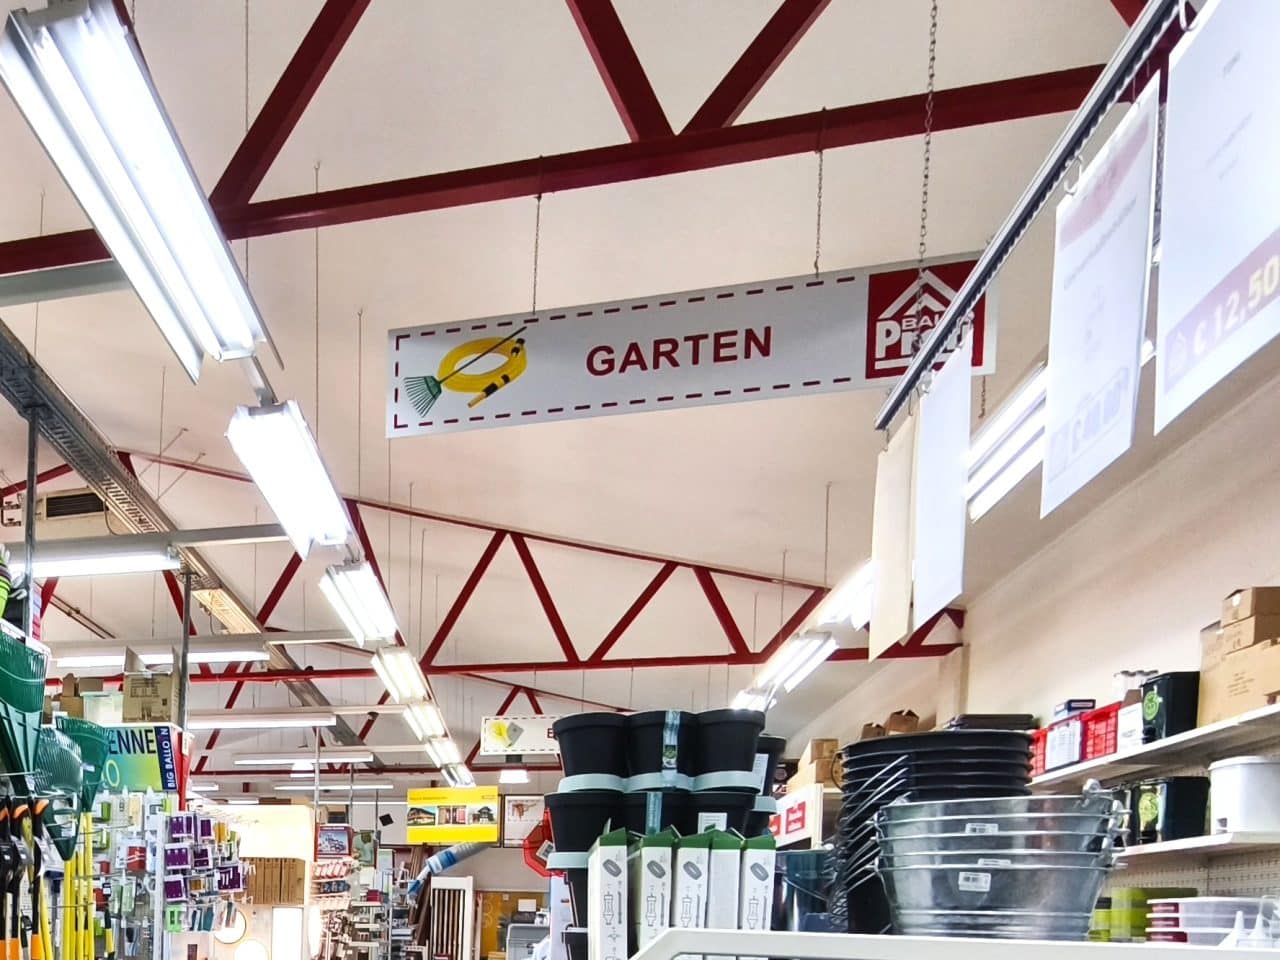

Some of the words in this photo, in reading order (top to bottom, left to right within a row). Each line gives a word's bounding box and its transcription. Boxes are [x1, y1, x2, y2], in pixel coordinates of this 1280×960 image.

[1214, 254, 1280, 338] 12,50
[586, 325, 772, 376] GARTEN
[166, 772, 176, 788] BIG
